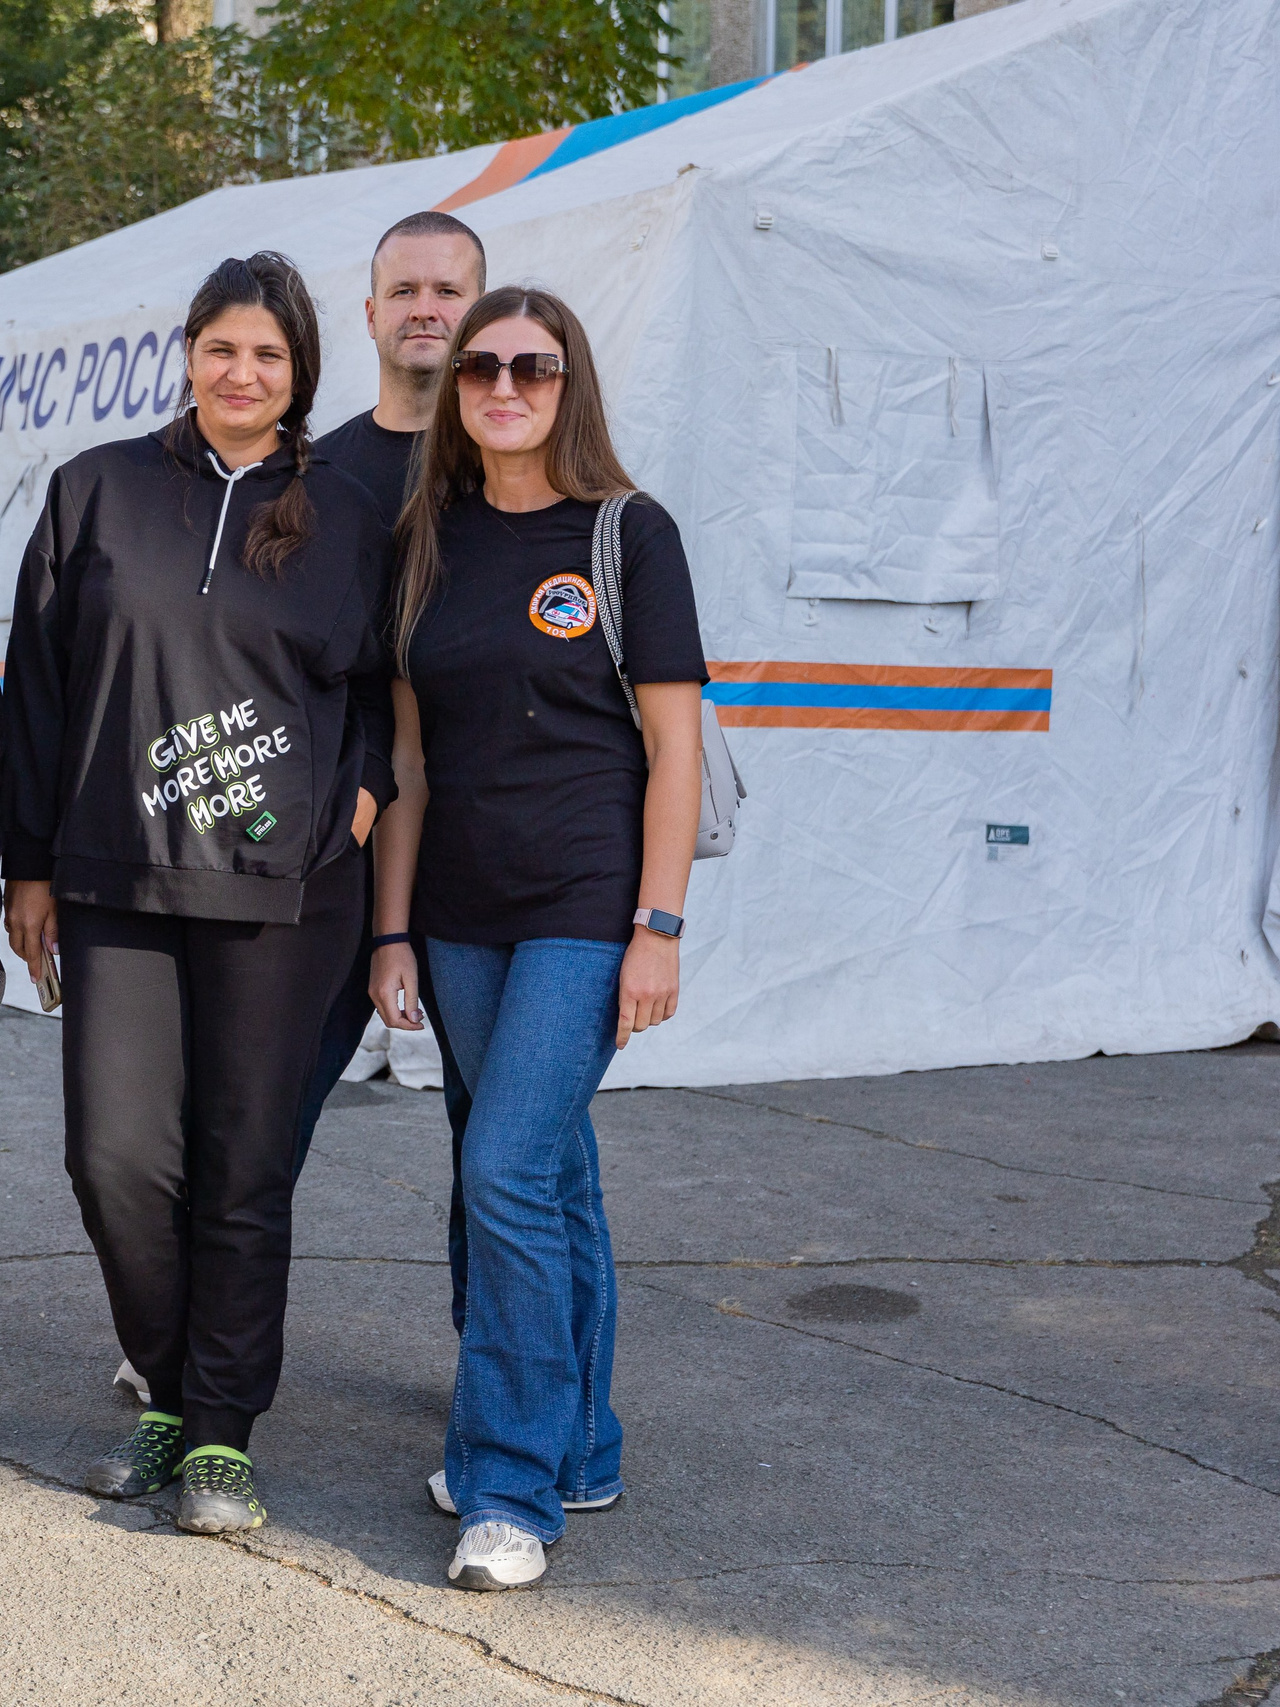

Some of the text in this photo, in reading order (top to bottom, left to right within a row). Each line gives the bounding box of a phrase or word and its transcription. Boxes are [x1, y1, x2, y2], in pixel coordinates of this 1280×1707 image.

[66, 325, 185, 426] РОСС
[543, 576, 591, 596] МЕДИЦИНСКАЯ
[546, 626, 567, 638] 103
[220, 699, 258, 736] ME
[142, 726, 291, 816] MORE MORE
[189, 774, 267, 832] MORE
